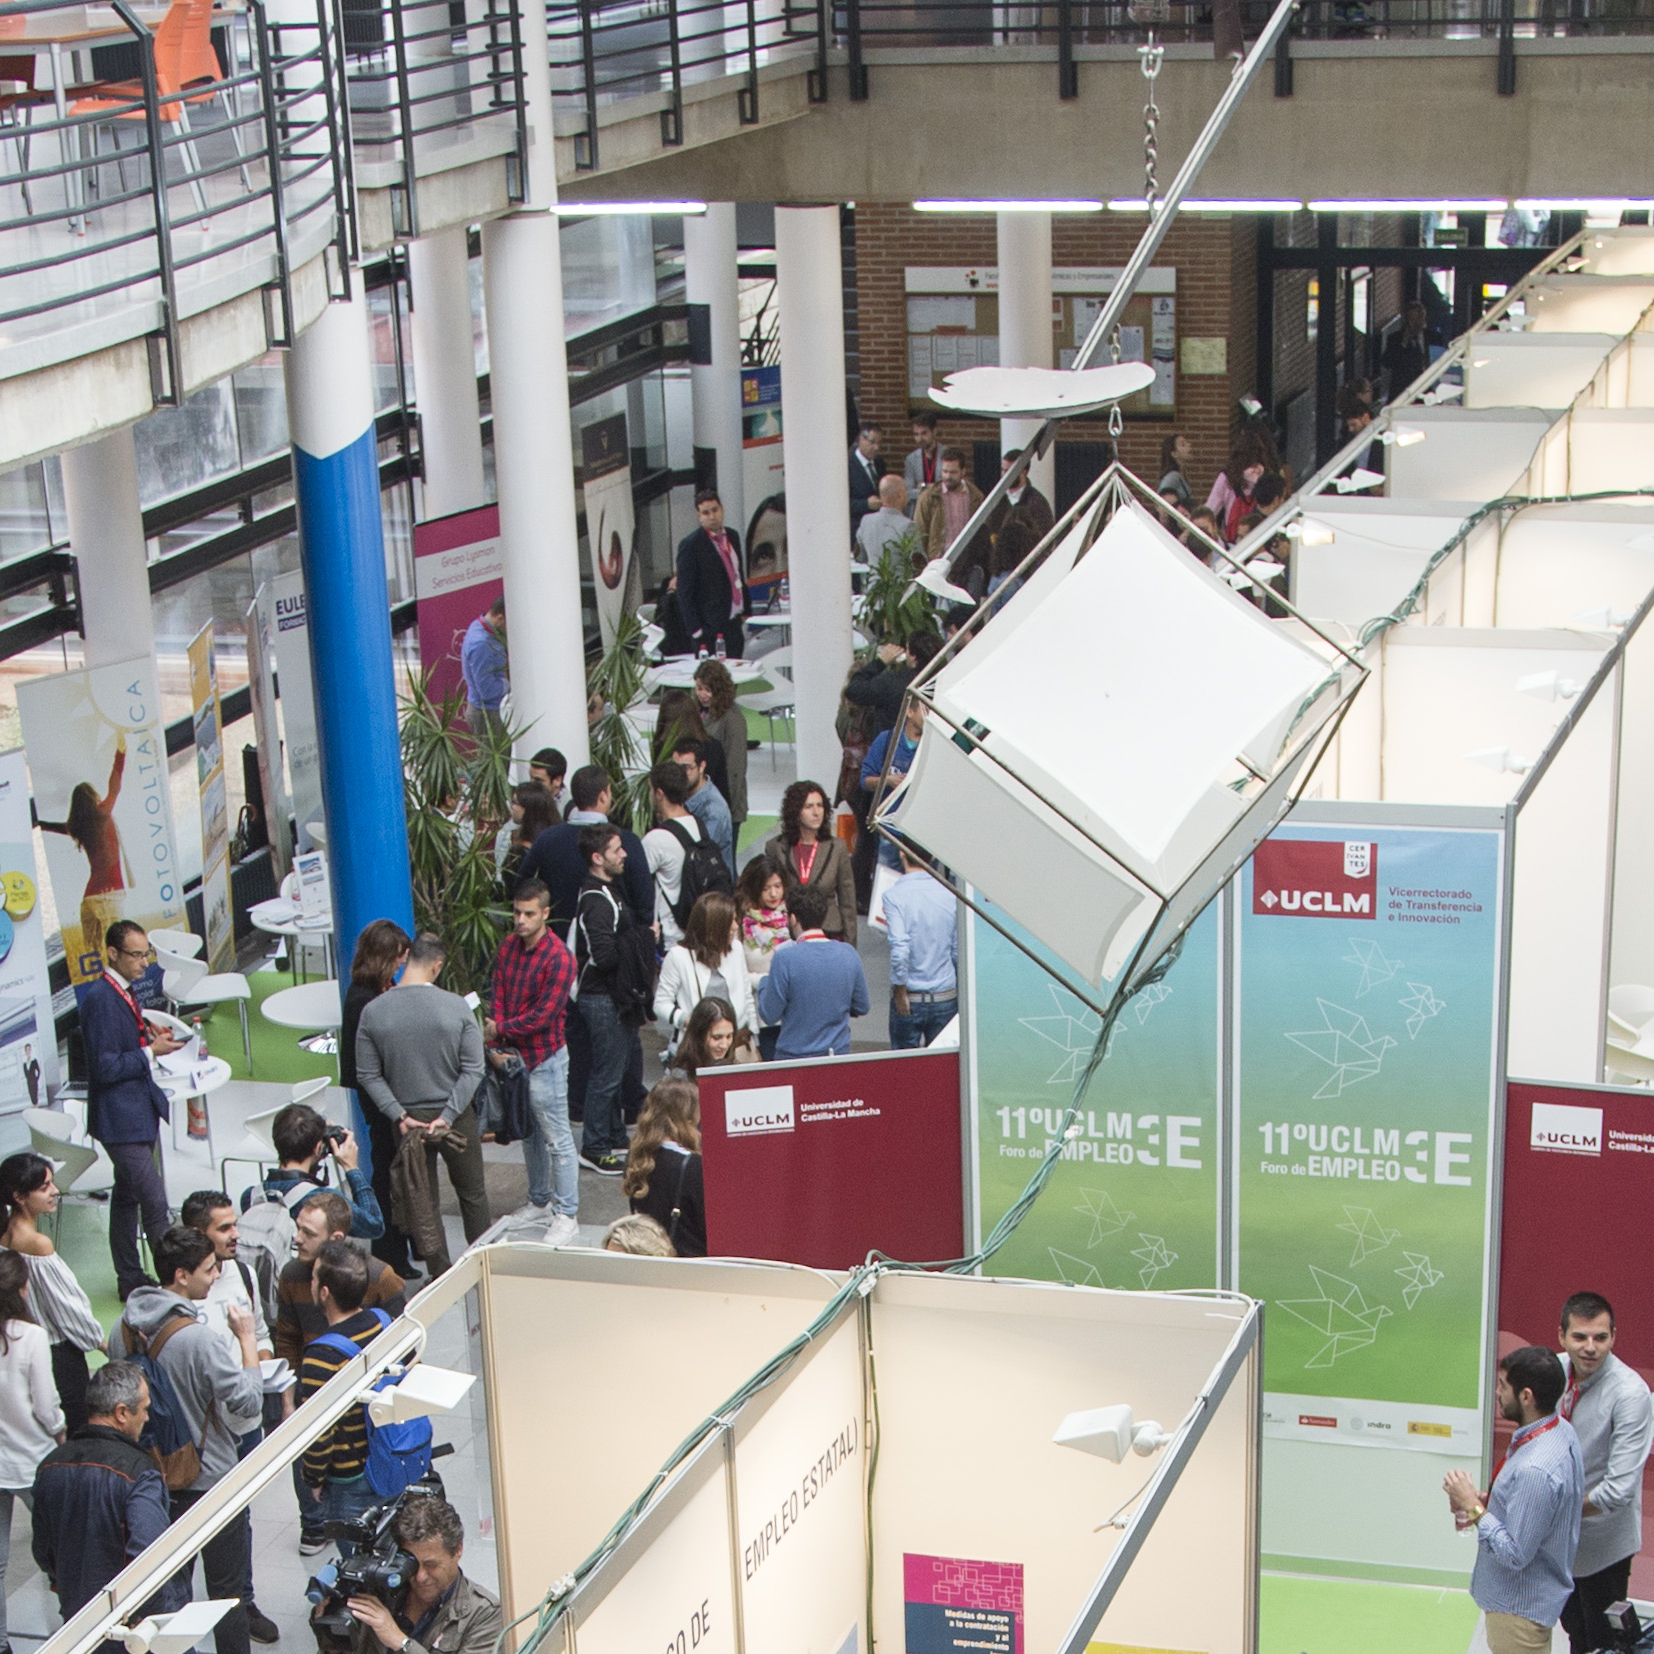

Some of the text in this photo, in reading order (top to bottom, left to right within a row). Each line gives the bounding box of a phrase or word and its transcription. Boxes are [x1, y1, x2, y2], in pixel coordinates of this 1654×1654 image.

[466, 561, 504, 582] Educativo
[276, 595, 306, 616] EULE
[127, 679, 177, 919] FOTOVOLTAICA
[1349, 844, 1365, 852] CER
[1349, 860, 1365, 868] TES
[1388, 886, 1473, 900] Vicerrectorado
[1281, 889, 1370, 913] UCLM
[1388, 900, 1483, 913] de Transferencia
[1388, 912, 1461, 925] e Innovación
[800, 1098, 864, 1112] Universidad de
[742, 1113, 790, 1127] UCLM
[801, 1107, 881, 1123] Castilla-La Mancha
[1547, 1132, 1597, 1147] UCLM
[999, 1143, 1025, 1160] Foro
[1027, 1144, 1043, 1161] de
[1403, 1129, 1473, 1187] 3E
[1260, 1154, 1401, 1183] Foro de EMPLEO
[745, 1416, 859, 1584] EMPLEO ESTATAL)
[690, 1598, 711, 1650] DE
[945, 1609, 1009, 1624] Medidas de apoyo
[956, 1619, 963, 1628] la
[964, 1621, 1009, 1632] contratación
[1001, 1633, 1009, 1641] al
[953, 1639, 1009, 1651] emprendimiento
